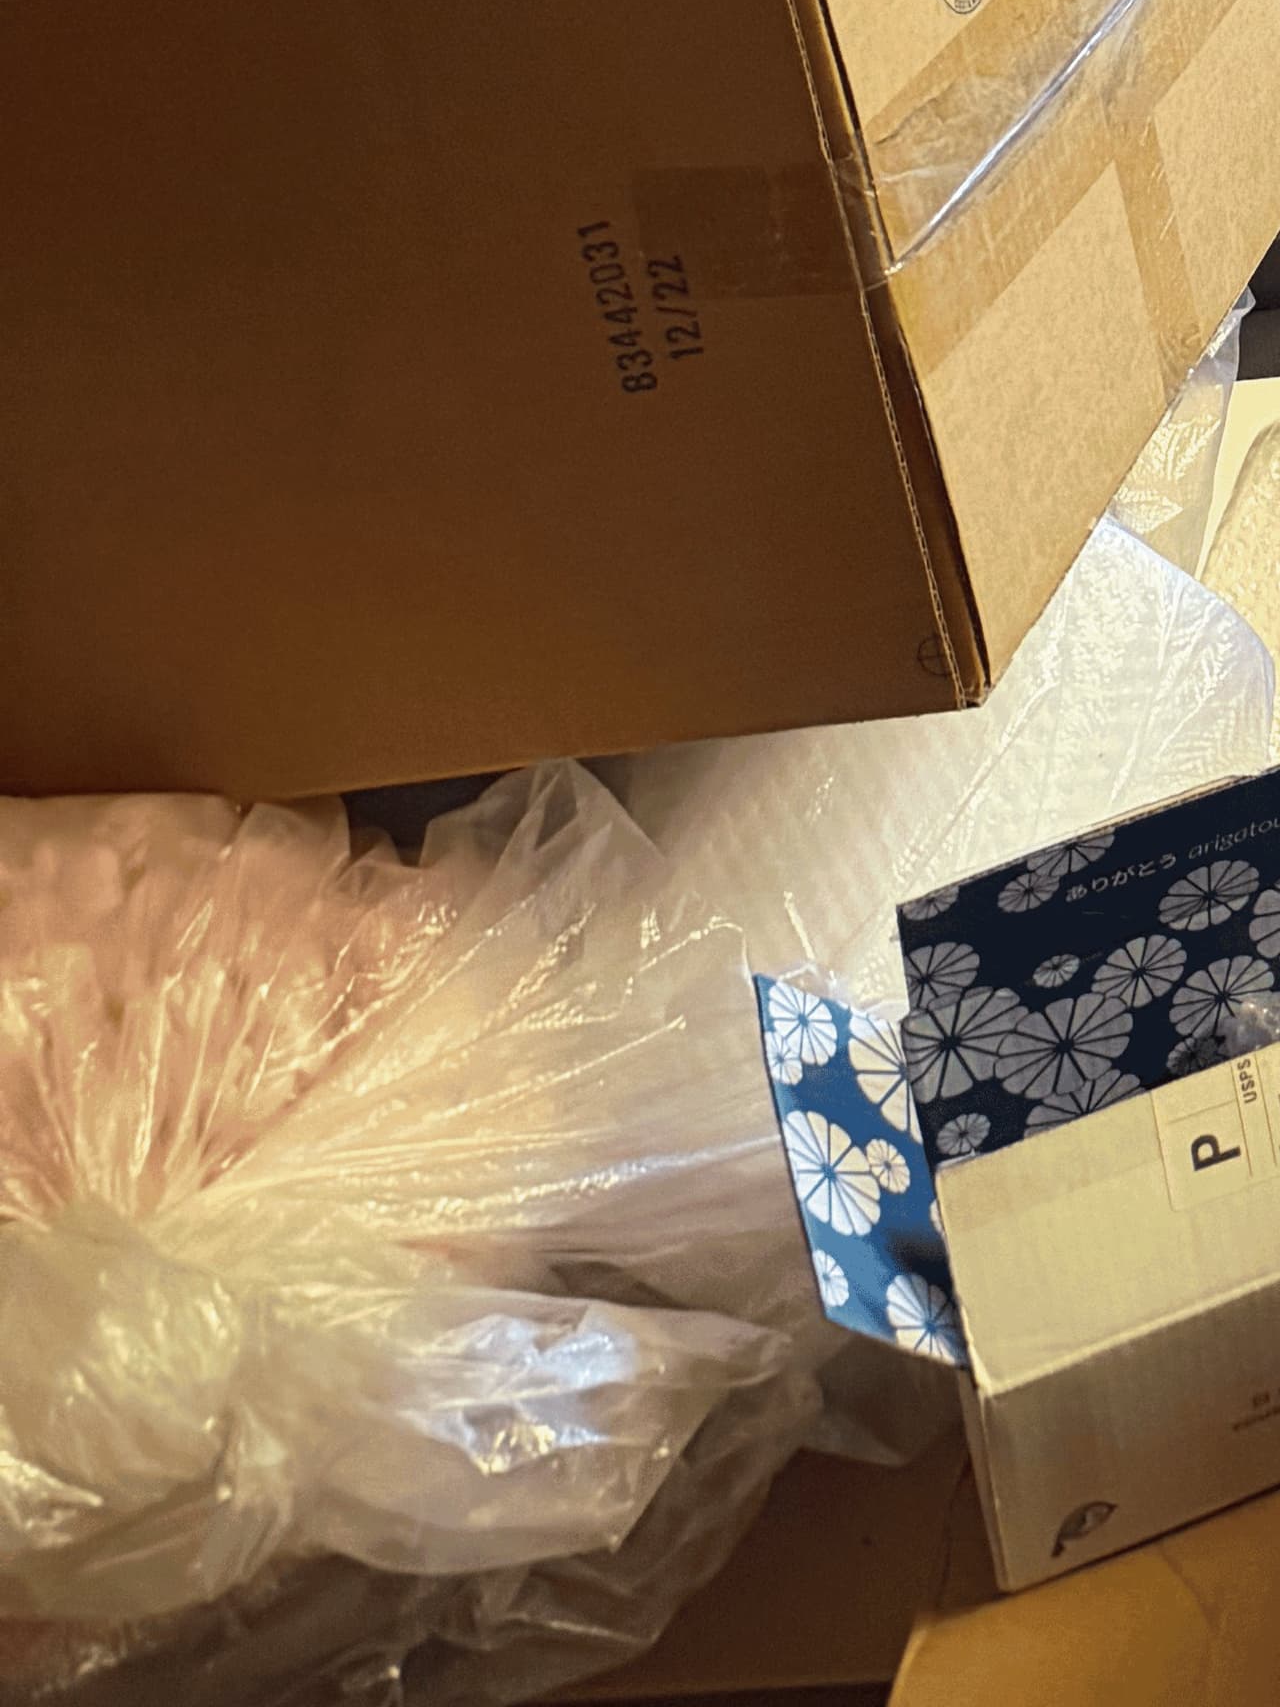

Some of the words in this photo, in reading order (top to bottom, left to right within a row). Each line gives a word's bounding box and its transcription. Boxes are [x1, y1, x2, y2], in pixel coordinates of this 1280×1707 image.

[643, 251, 705, 361] 12/22
[1064, 851, 1180, 905] ありがとう
[1238, 1058, 1257, 1106] USPS
[1190, 1132, 1242, 1173] P
